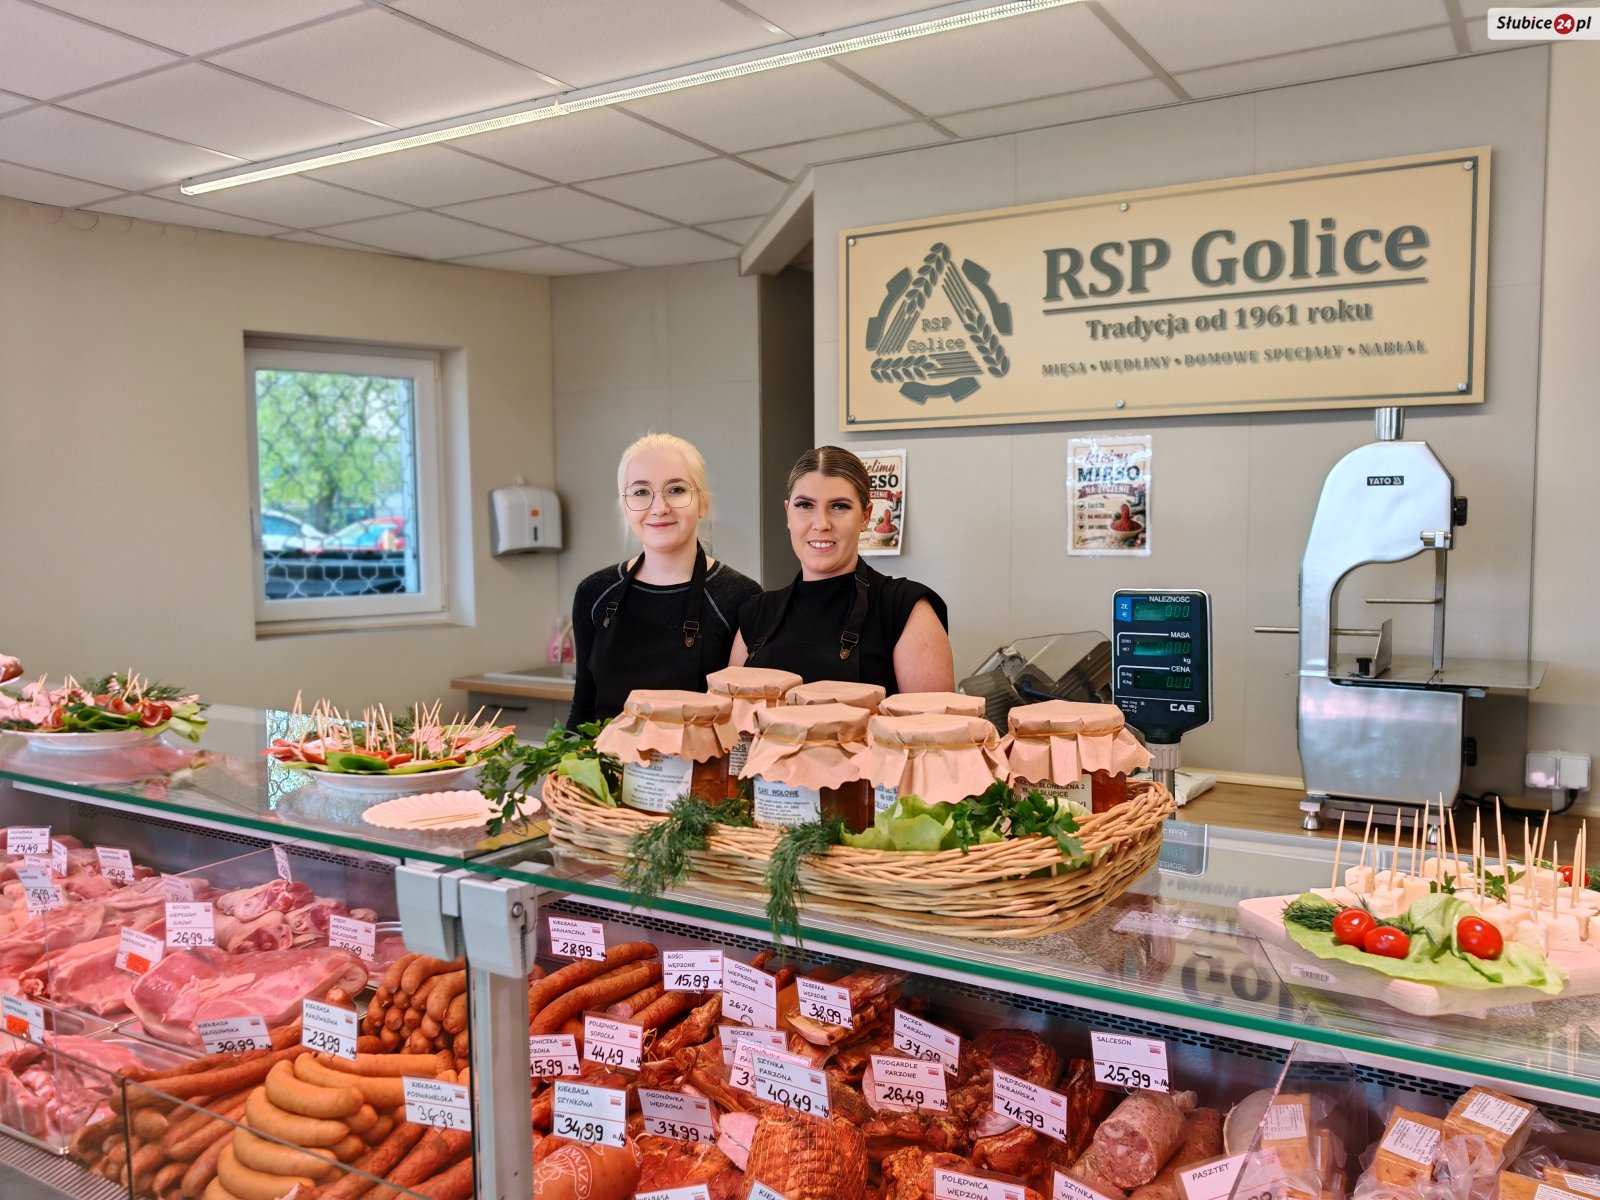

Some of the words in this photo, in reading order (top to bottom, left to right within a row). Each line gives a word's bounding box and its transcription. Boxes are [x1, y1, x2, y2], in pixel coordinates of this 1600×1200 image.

[1043, 238, 1171, 302] RSP
[1192, 217, 1429, 288] Golice
[921, 316, 953, 332] RSP
[1086, 313, 1188, 341] Tradycja
[1195, 308, 1227, 333] od
[1235, 303, 1300, 330] 1961
[1307, 299, 1373, 324] roku
[907, 336, 967, 354] Golice
[1042, 360, 1087, 378] MIĘSA
[1099, 354, 1171, 377] WĘDLINY
[1184, 349, 1259, 368] DOMOWE
[1263, 344, 1344, 364] SPECJAŁY
[1358, 339, 1429, 358] NABIAŁ
[1170, 704, 1195, 712] CAS
[728, 999, 754, 1014] 26,76
[588, 1020, 620, 1032] POLĘDWICA
[900, 1013, 923, 1028] BOCZEK
[904, 1024, 932, 1040] PARZONY
[1096, 1036, 1132, 1046] SALCESON
[757, 1057, 784, 1070] SZYNKA
[876, 1060, 918, 1069] PODGARDLE
[759, 1068, 792, 1082] PARZONA
[885, 1070, 917, 1078] PARZONE
[558, 1085, 590, 1096] KIEŁBASA
[998, 1074, 1038, 1094] WĘDZONKA
[646, 1092, 684, 1102] OGONÓWKA
[996, 1082, 1036, 1103] UKRAIŃSKA
[557, 1096, 594, 1108] SZYNKOWA
[650, 1101, 684, 1111] WĘDZONA
[1192, 1162, 1230, 1181] PASZTET
[942, 1174, 988, 1190] POLĘDWICA
[946, 1188, 989, 1200] WĘDZONA
[1064, 1181, 1094, 1200] SZYNKA
